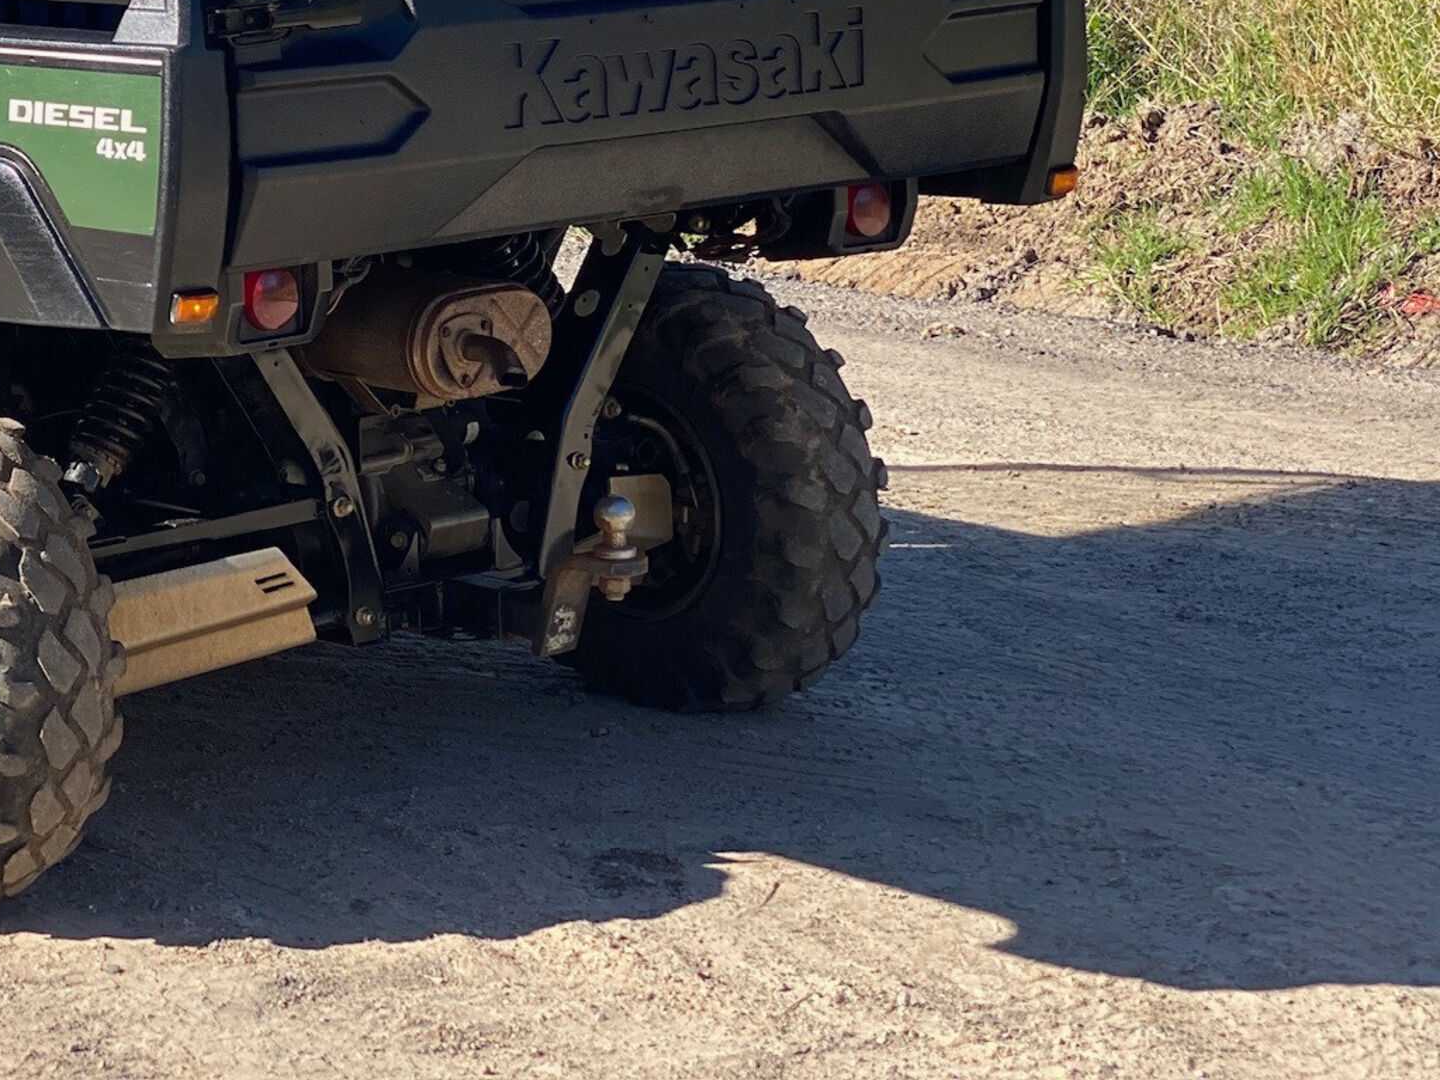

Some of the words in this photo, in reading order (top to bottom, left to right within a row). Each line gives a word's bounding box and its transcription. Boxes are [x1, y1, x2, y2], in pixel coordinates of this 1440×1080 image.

[502, 6, 865, 130] Kawasaki
[8, 98, 148, 134] DIESEL
[96, 137, 147, 162] 4x4
